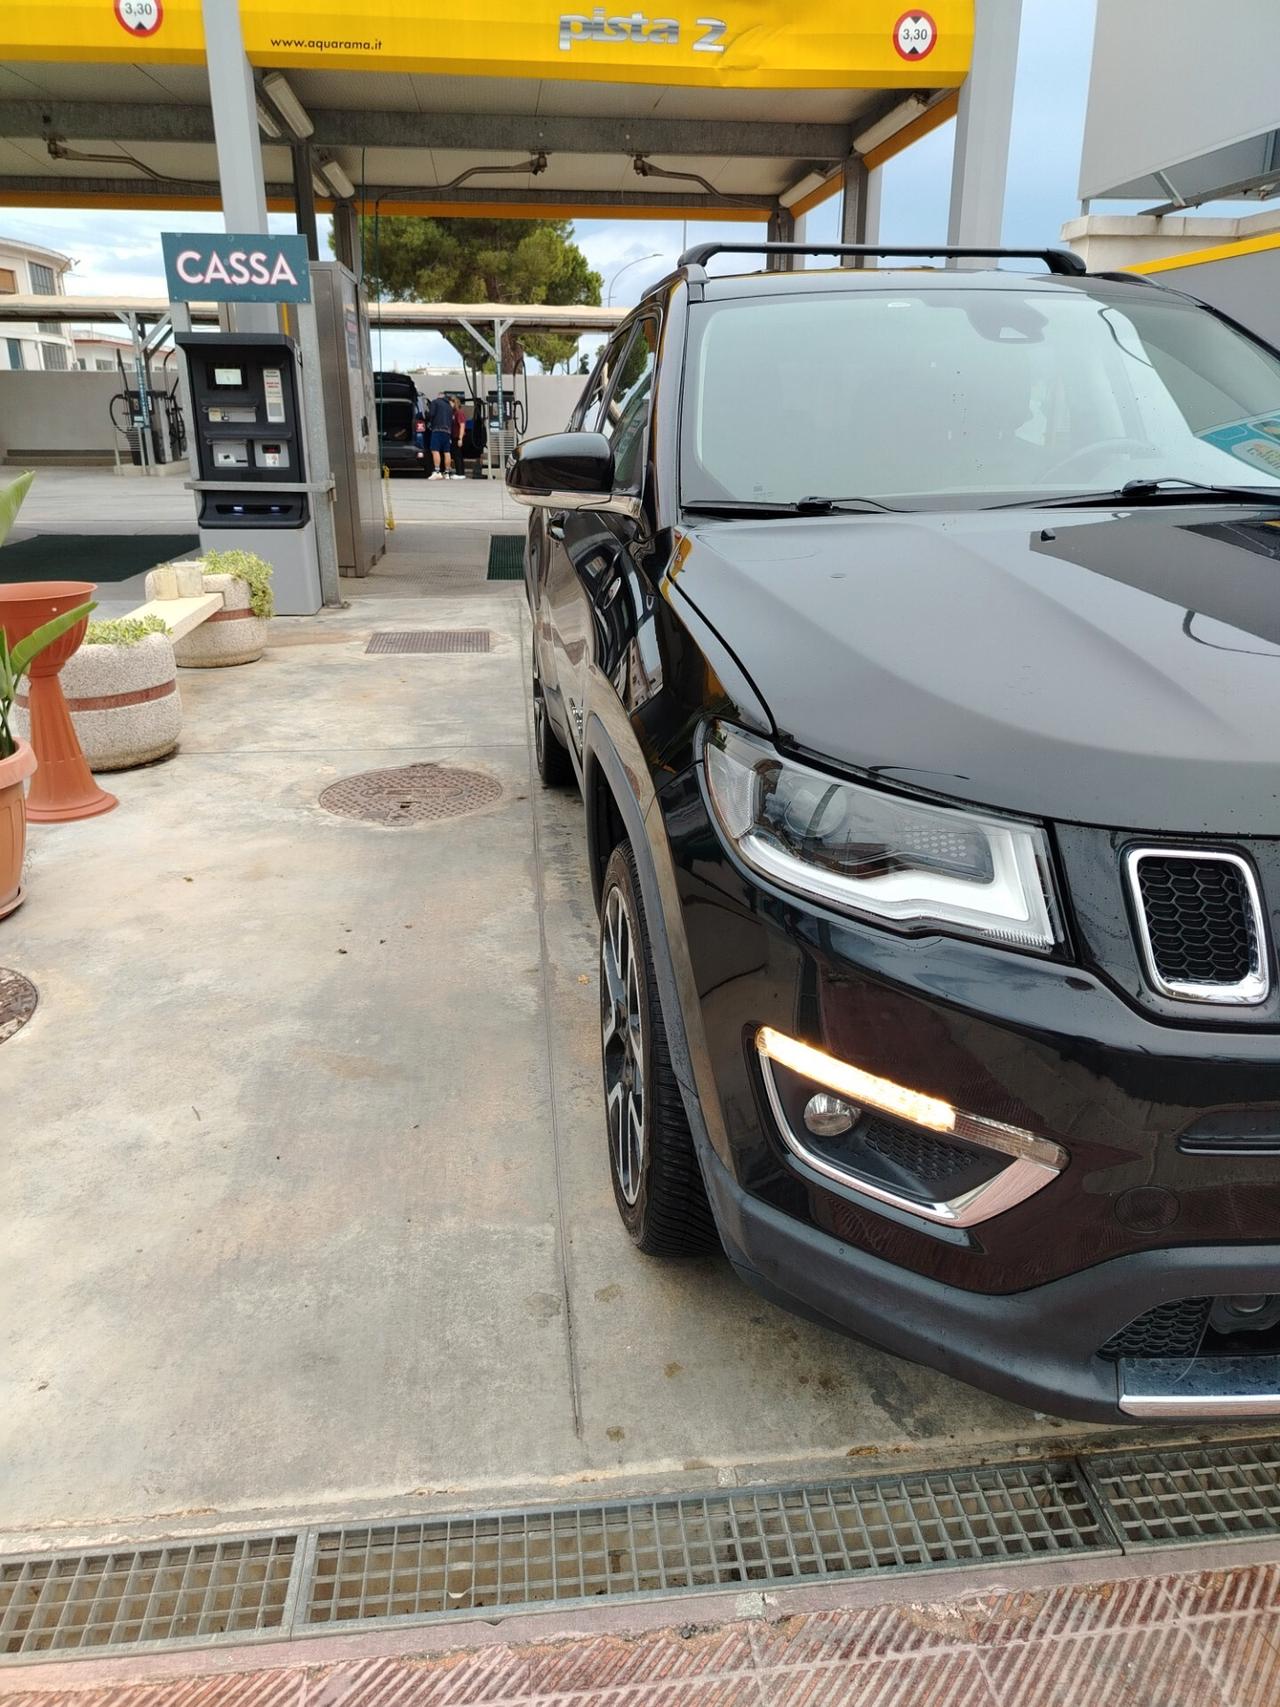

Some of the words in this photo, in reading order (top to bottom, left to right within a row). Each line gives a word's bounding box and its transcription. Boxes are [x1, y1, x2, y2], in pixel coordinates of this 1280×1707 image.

[125, 2, 152, 16] 3,30
[559, 7, 679, 50] pista
[693, 18, 727, 52] 2
[903, 28, 927, 42] 3,30
[270, 39, 382, 51] www.aquarama.it
[176, 250, 298, 285] CASSA
